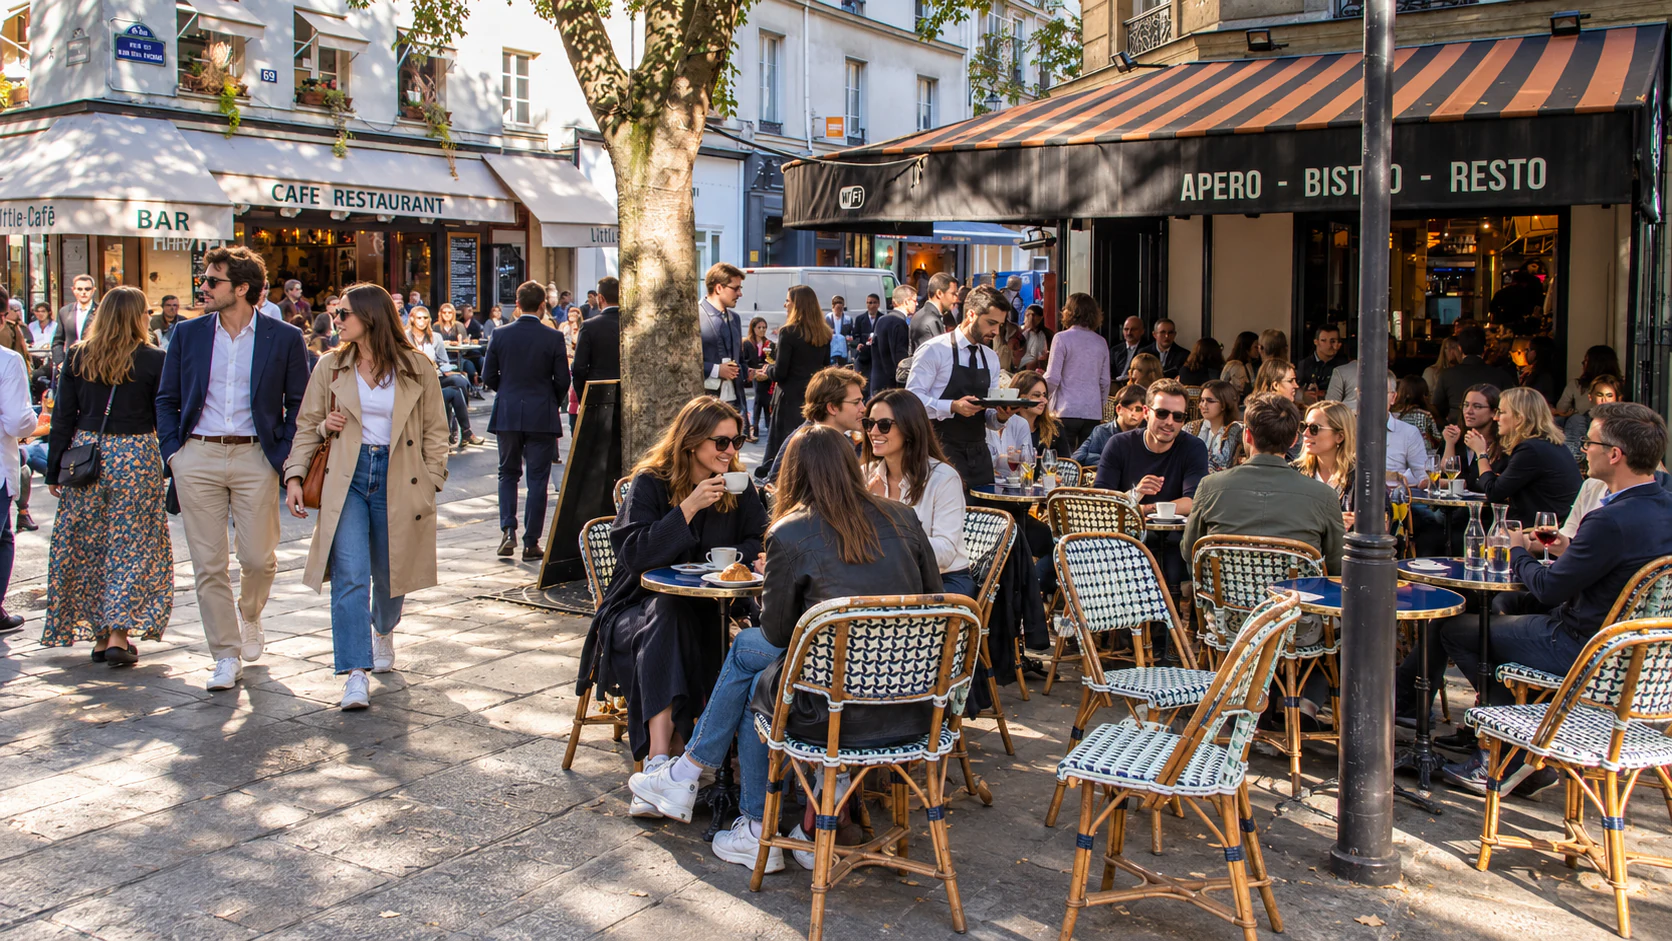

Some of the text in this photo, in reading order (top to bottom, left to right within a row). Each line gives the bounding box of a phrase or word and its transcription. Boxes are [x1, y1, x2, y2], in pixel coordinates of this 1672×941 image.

[263, 70, 275, 81] 69
[1180, 169, 1262, 201] APERO
[1304, 163, 1402, 197] BISTO
[1450, 157, 1547, 193] RESTO
[271, 184, 445, 214] CAFE RESTAURANT
[137, 209, 190, 231] BAR
